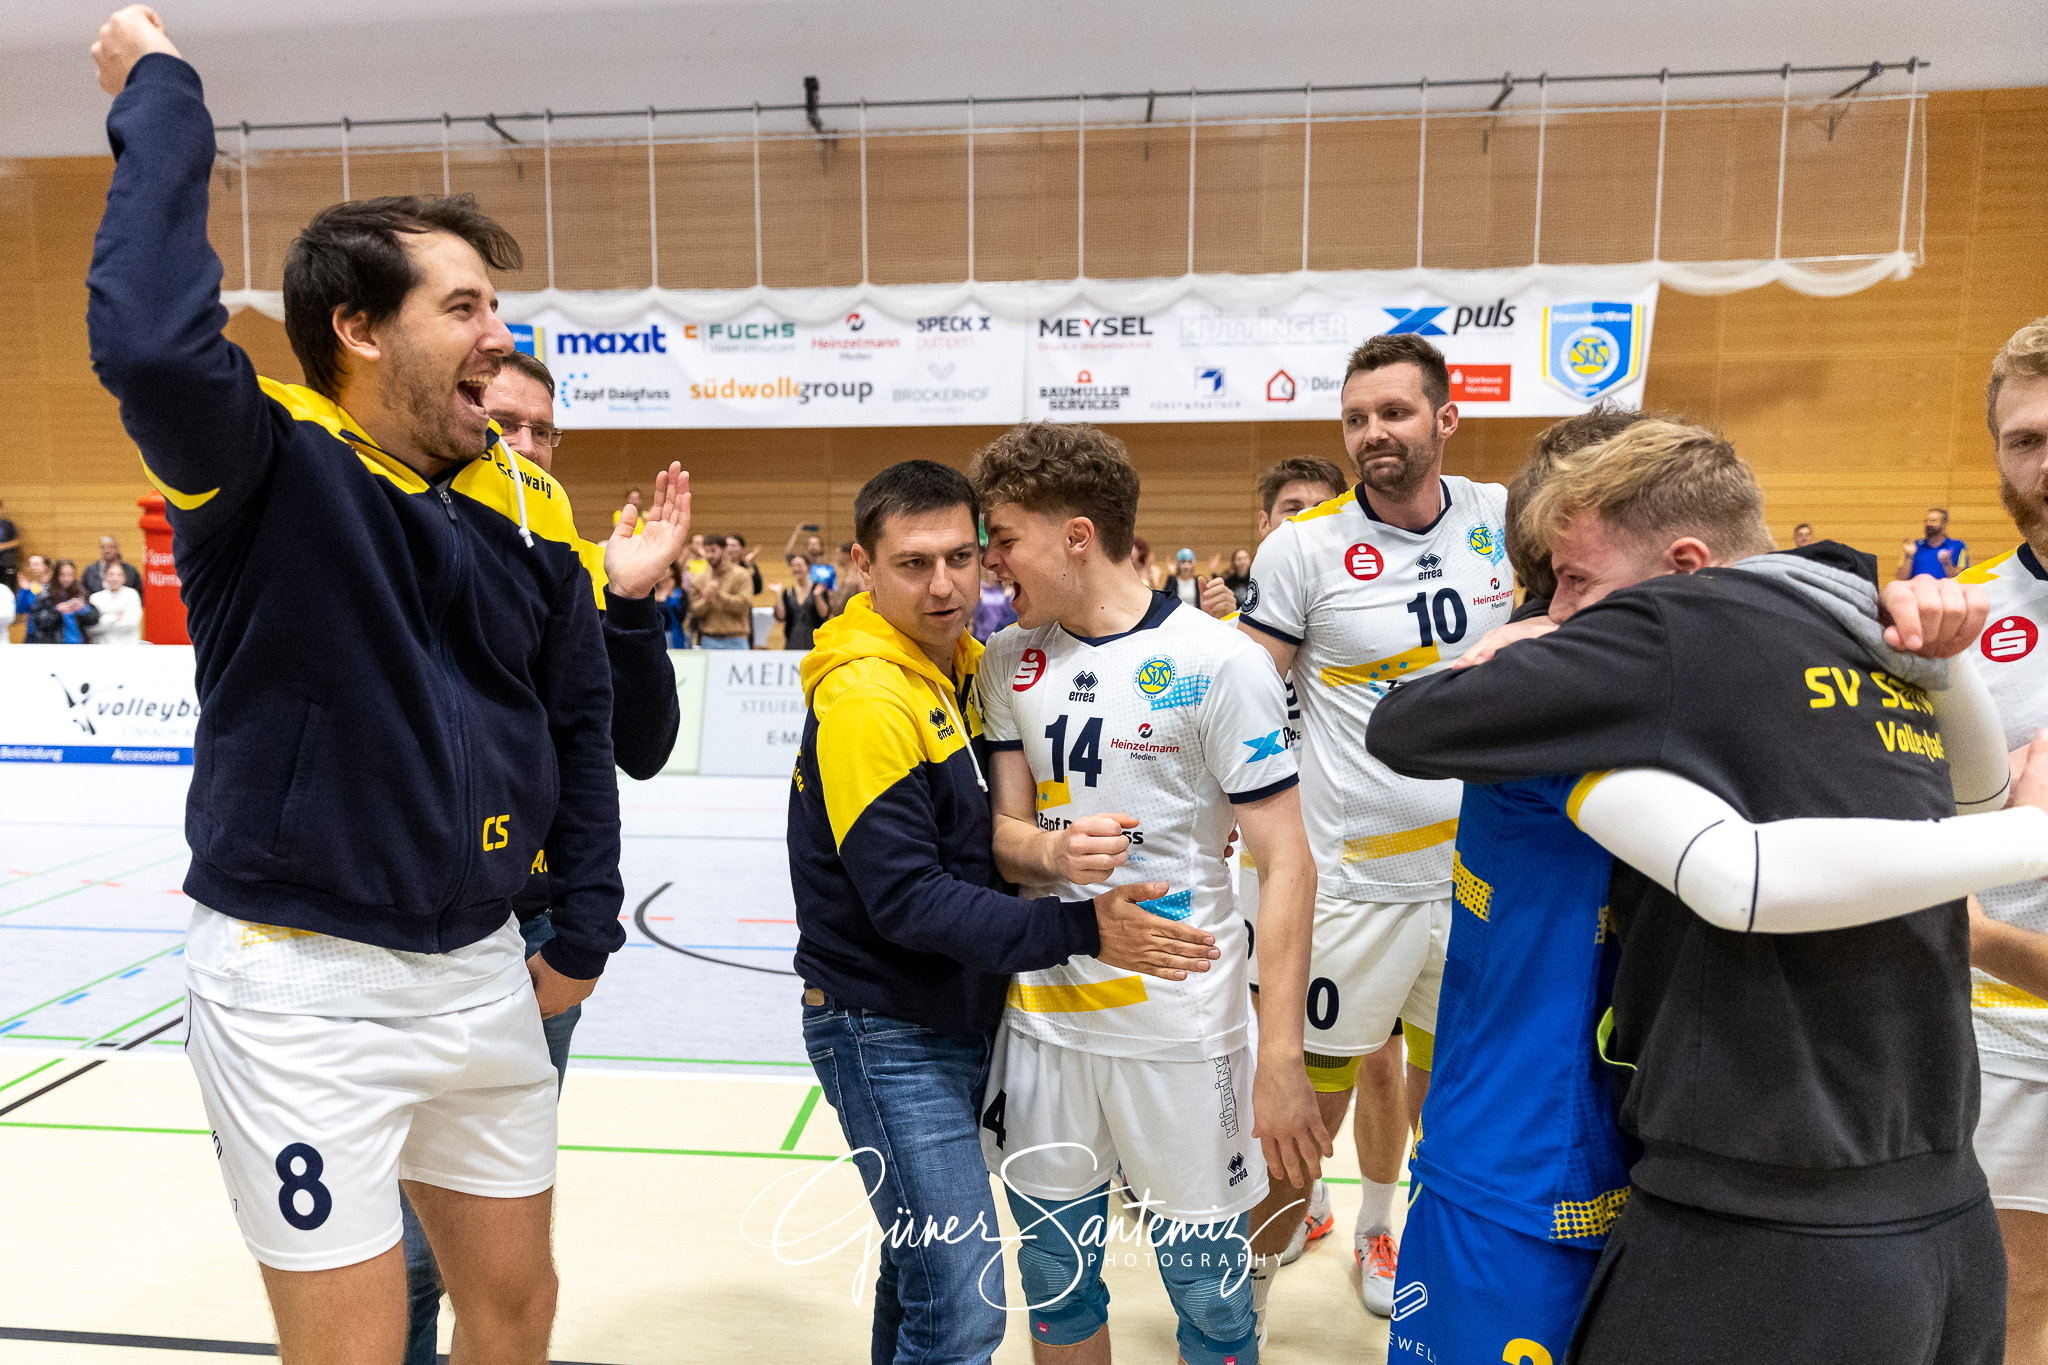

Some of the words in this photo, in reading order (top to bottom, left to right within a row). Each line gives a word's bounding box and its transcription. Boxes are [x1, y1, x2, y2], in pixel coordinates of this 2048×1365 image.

[916, 315, 972, 333] SPECK
[1453, 298, 1517, 335] puls
[709, 322, 797, 339] FUCHS
[1038, 315, 1154, 338] MEYSEL
[557, 324, 667, 354] maxit
[811, 337, 901, 350] Heinzelmann
[574, 388, 604, 403] Zapf
[608, 388, 670, 404] Daigfuss
[1048, 399, 1121, 412] SERVICES
[1418, 568, 1443, 581] errea
[1407, 587, 1468, 648] 10
[1068, 690, 1096, 703] errea
[1804, 666, 1861, 709] SV
[937, 724, 955, 741] errea
[1044, 714, 1104, 788] 14
[1110, 737, 1180, 754] Heinzelmann
[1129, 752, 1157, 761] Medien
[482, 814, 510, 852] CS
[1228, 1167, 1248, 1186] errea
[275, 1142, 333, 1231] 8
